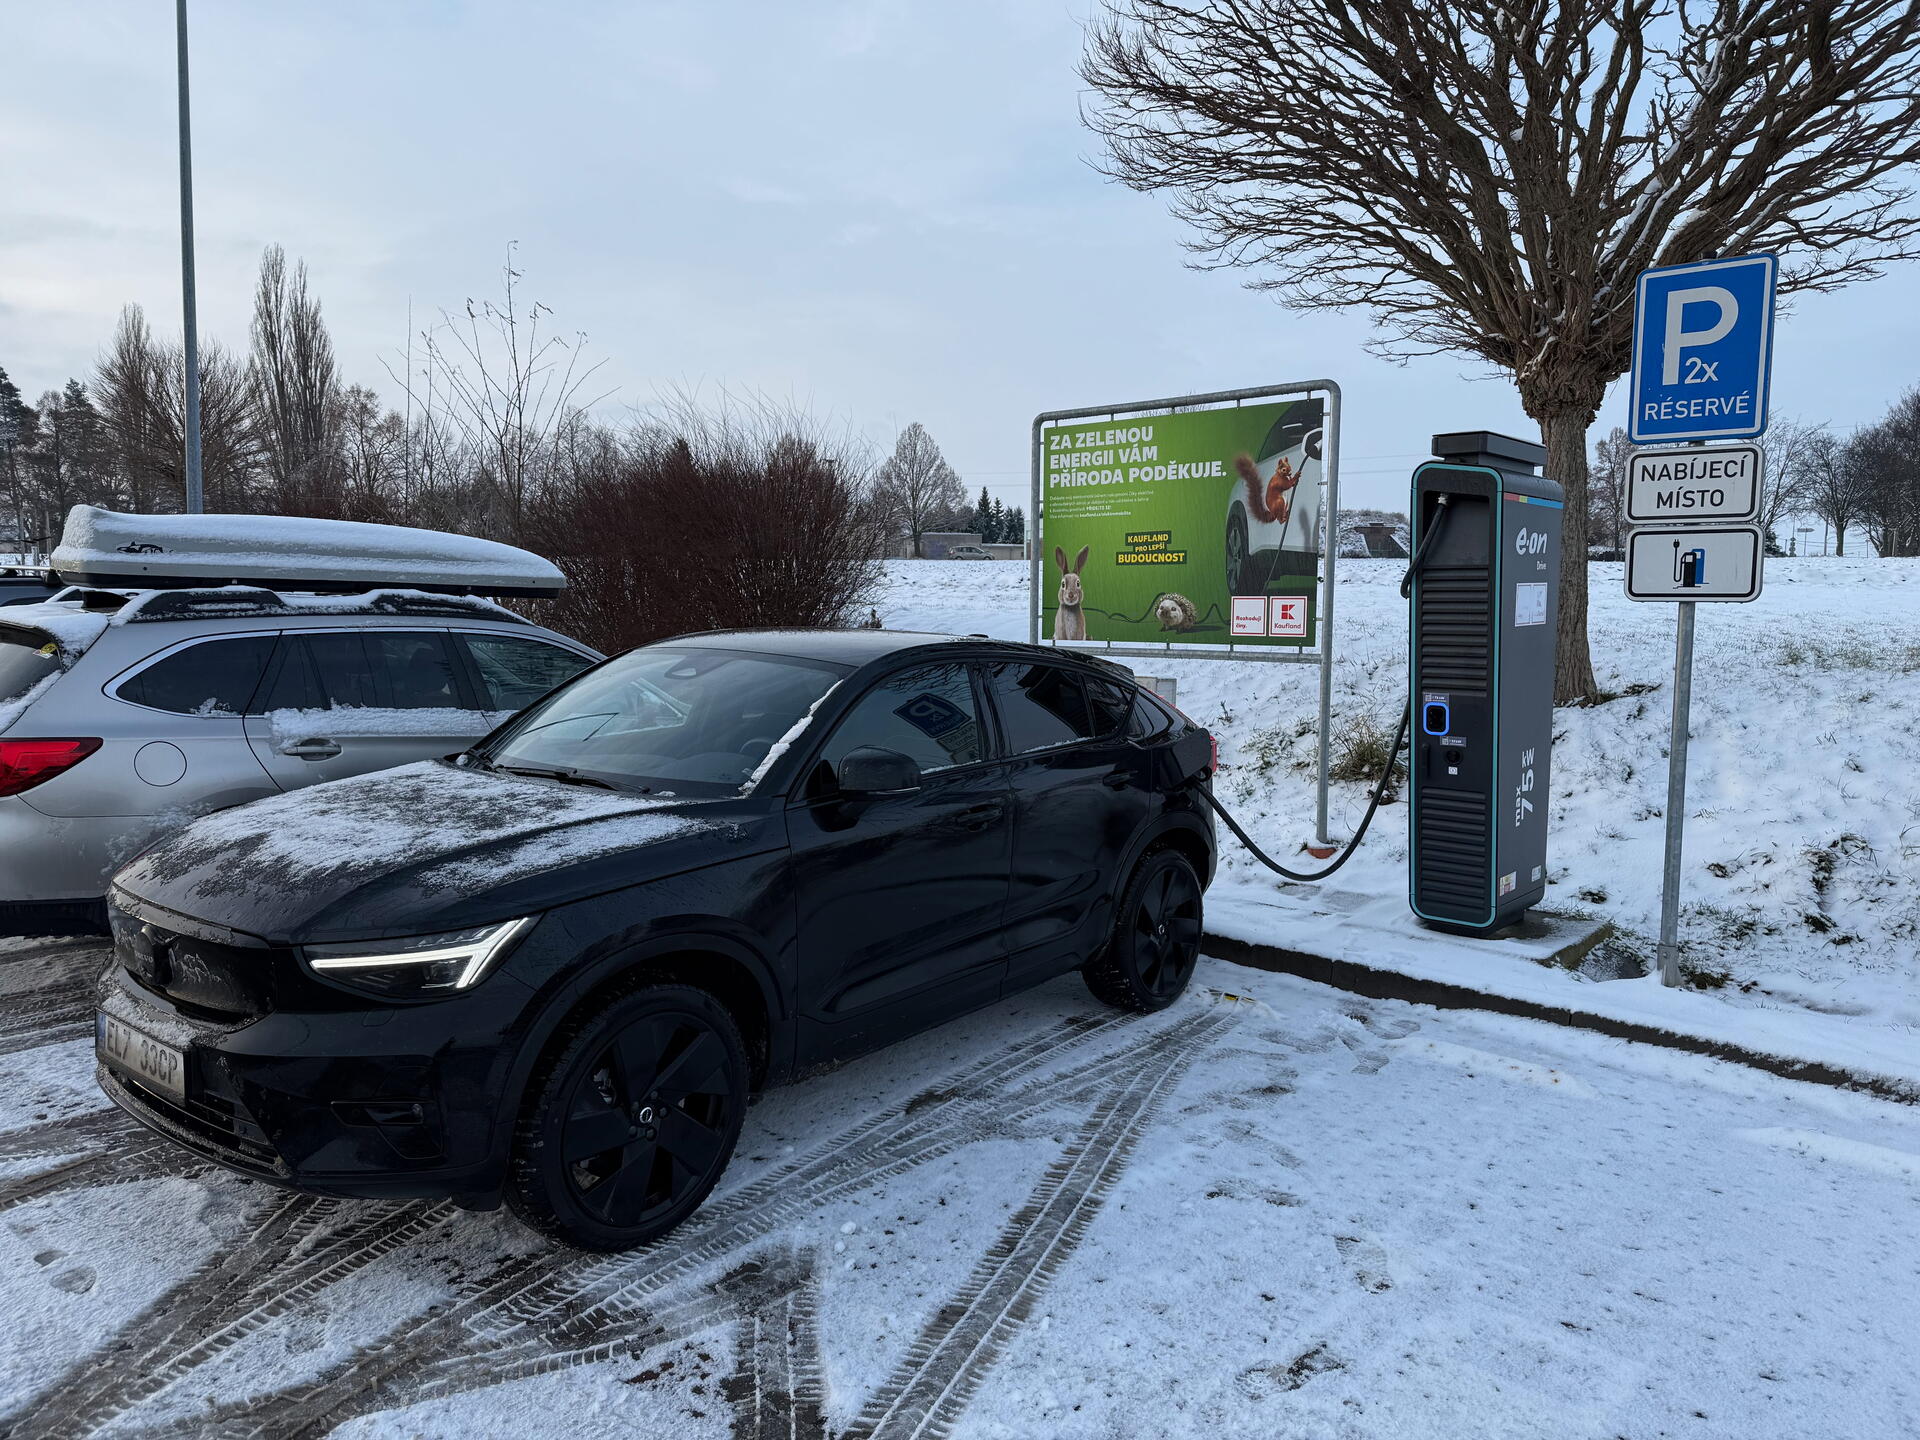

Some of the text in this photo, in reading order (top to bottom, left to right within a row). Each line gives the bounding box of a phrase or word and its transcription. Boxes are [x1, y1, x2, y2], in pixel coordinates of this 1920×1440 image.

[1662, 286, 1739, 386] P
[1684, 357, 1719, 385] 2x
[1644, 390, 1750, 421] RÉSERVÉ
[1050, 426, 1153, 450] ZA ZELENOU
[1050, 443, 1158, 469] ENERGII VÁM
[1641, 455, 1748, 482] NABÍJECÍ
[1050, 460, 1227, 488] PŘÍRODA PODĚKUJE.
[1656, 486, 1724, 509] MÍSTO
[1127, 534, 1169, 543] KAUFLAND
[1118, 552, 1185, 563] BUDOUCNOST
[1521, 747, 1535, 820] 75 kW
[107, 1020, 178, 1084] EL7 33CP
